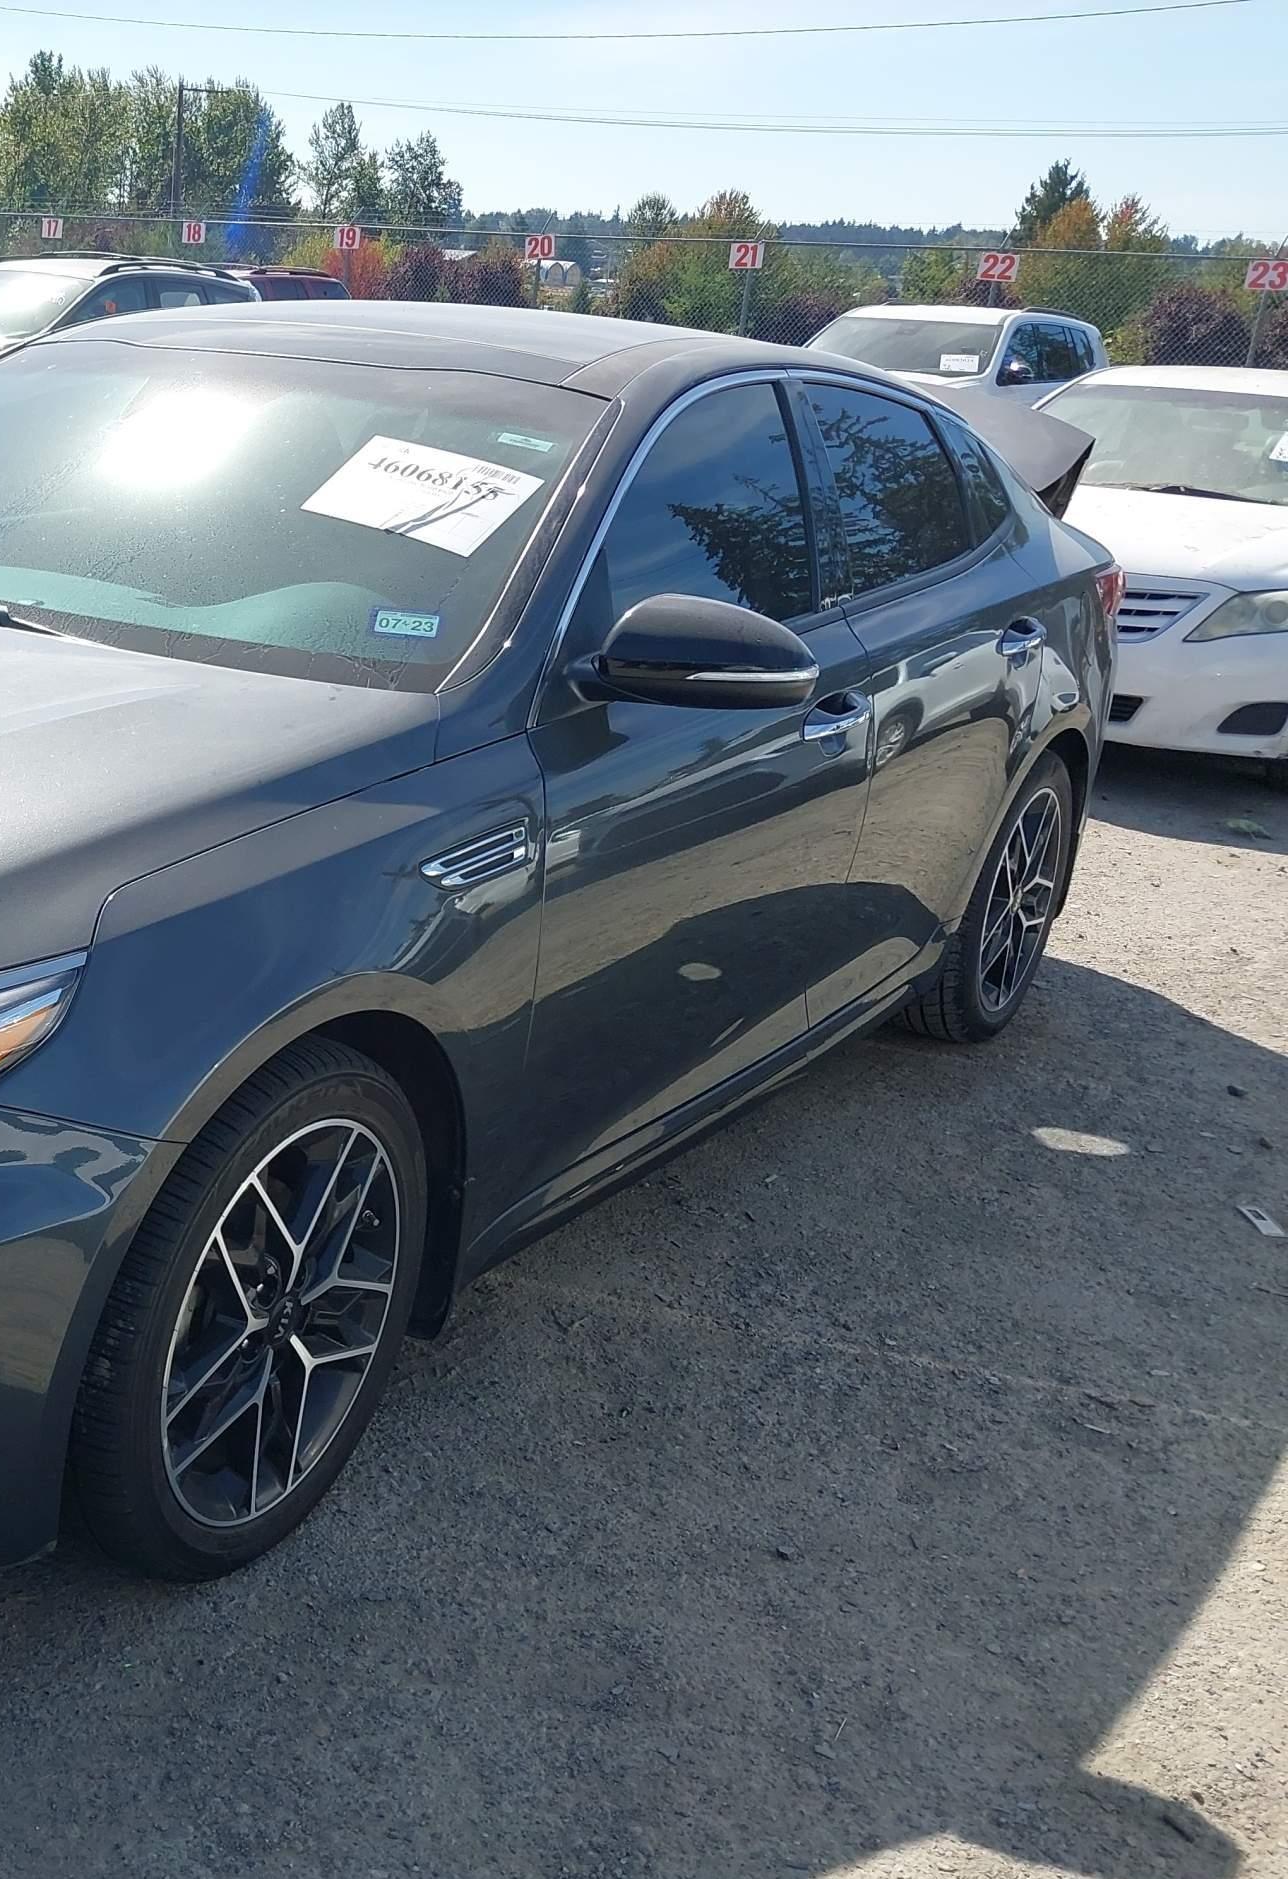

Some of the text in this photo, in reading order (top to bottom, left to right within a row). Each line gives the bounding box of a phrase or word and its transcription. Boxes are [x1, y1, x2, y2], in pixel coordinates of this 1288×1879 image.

[46, 219, 59, 237] 17
[186, 223, 201, 242] 18
[338, 227, 356, 248] 19
[527, 236, 553, 258] 20
[734, 244, 759, 267] 21
[980, 254, 1016, 280] 22
[1247, 261, 1288, 290] 23
